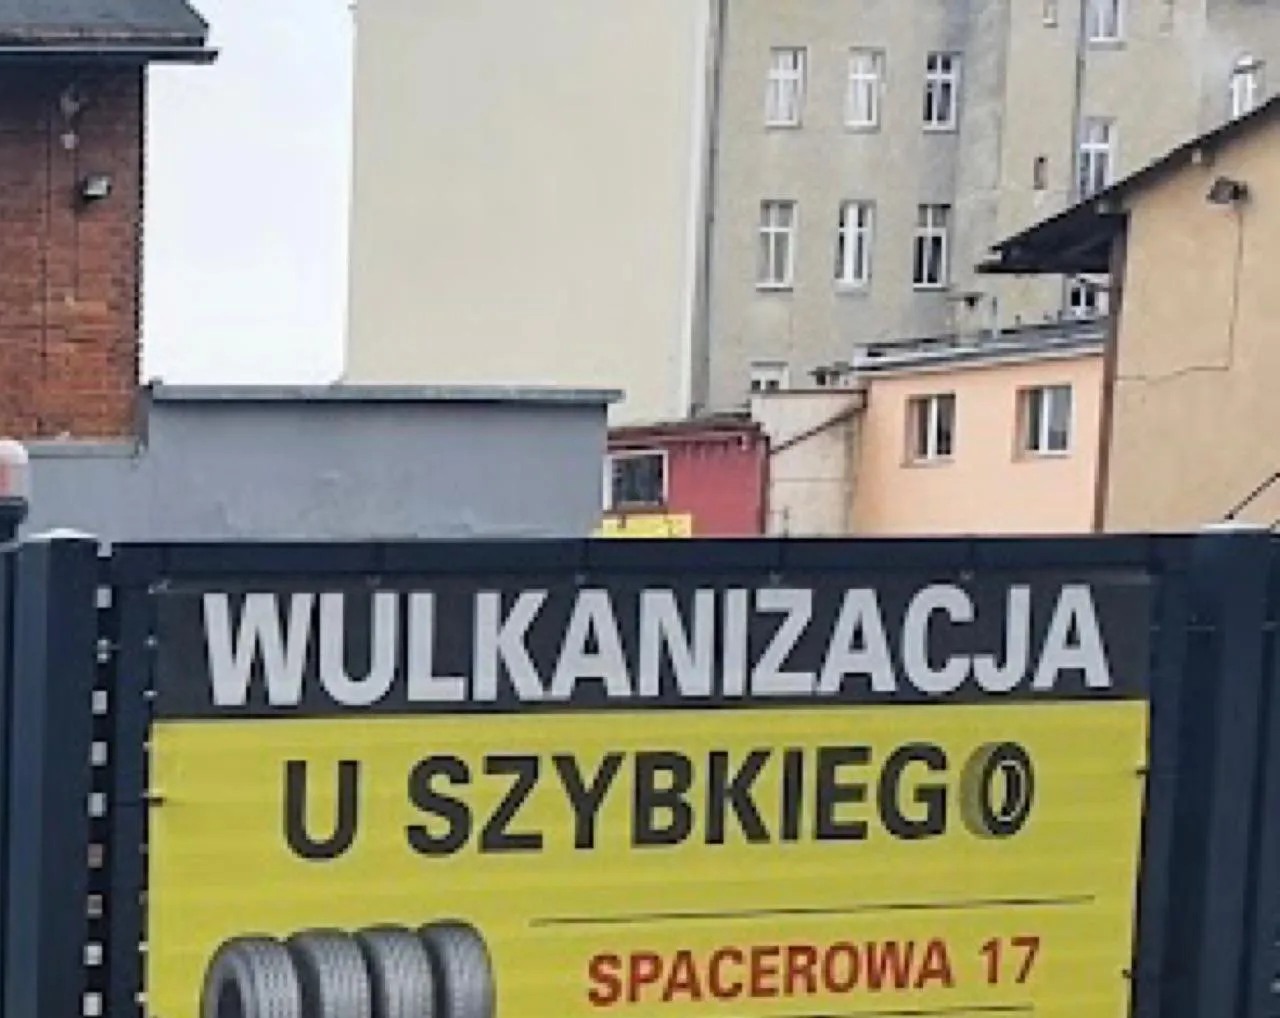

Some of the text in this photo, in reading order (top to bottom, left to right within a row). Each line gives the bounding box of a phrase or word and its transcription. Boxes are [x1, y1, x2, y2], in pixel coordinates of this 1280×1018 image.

[203, 583, 1113, 709] WULKANIZACJA
[284, 741, 1035, 859] U SZYBKIEGO
[587, 936, 1041, 1007] SPACEROWA 17
